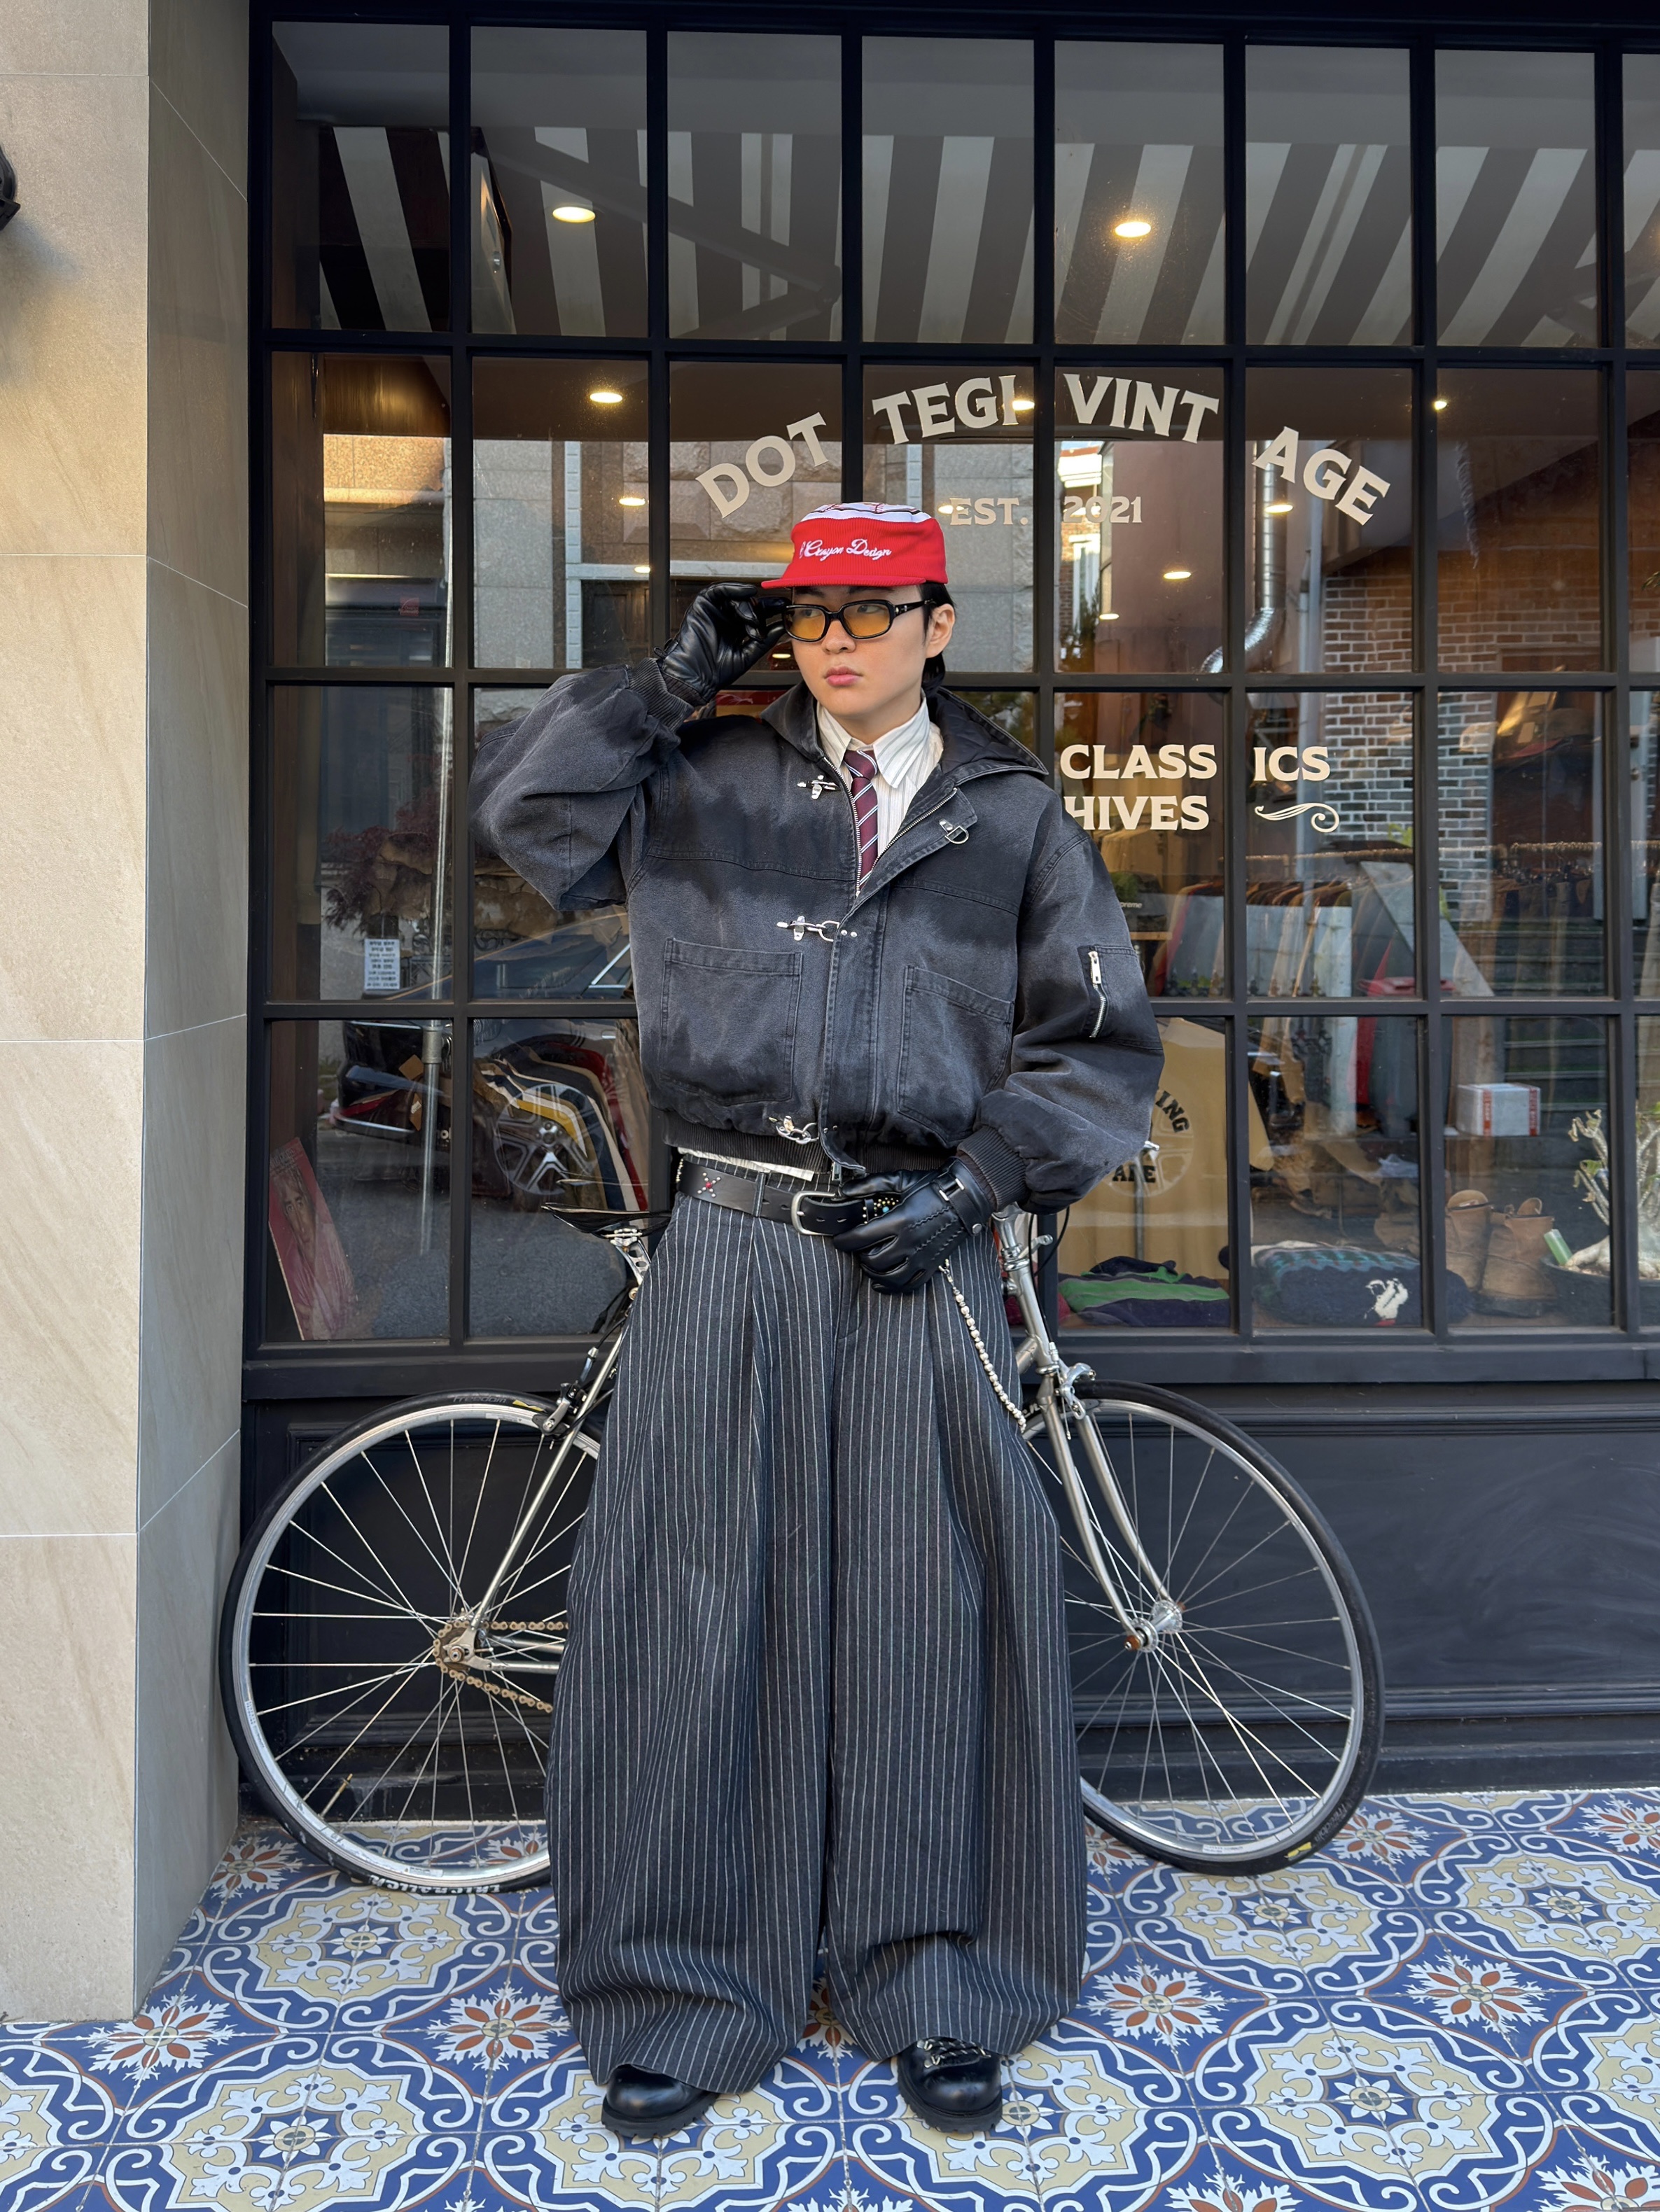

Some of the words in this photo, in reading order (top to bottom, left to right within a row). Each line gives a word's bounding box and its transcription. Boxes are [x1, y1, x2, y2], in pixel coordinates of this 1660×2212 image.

[695, 412, 828, 519] DOT
[872, 375, 1019, 444] TEGI
[1063, 374, 1219, 443] VINT
[1252, 427, 1390, 525] AGE
[949, 498, 1028, 525] EST.
[1063, 496, 1142, 524] 2021
[846, 538, 892, 561] Design
[1061, 744, 1217, 779] CLASS
[1254, 746, 1330, 781] ICS
[1063, 795, 1210, 830] HIVES
